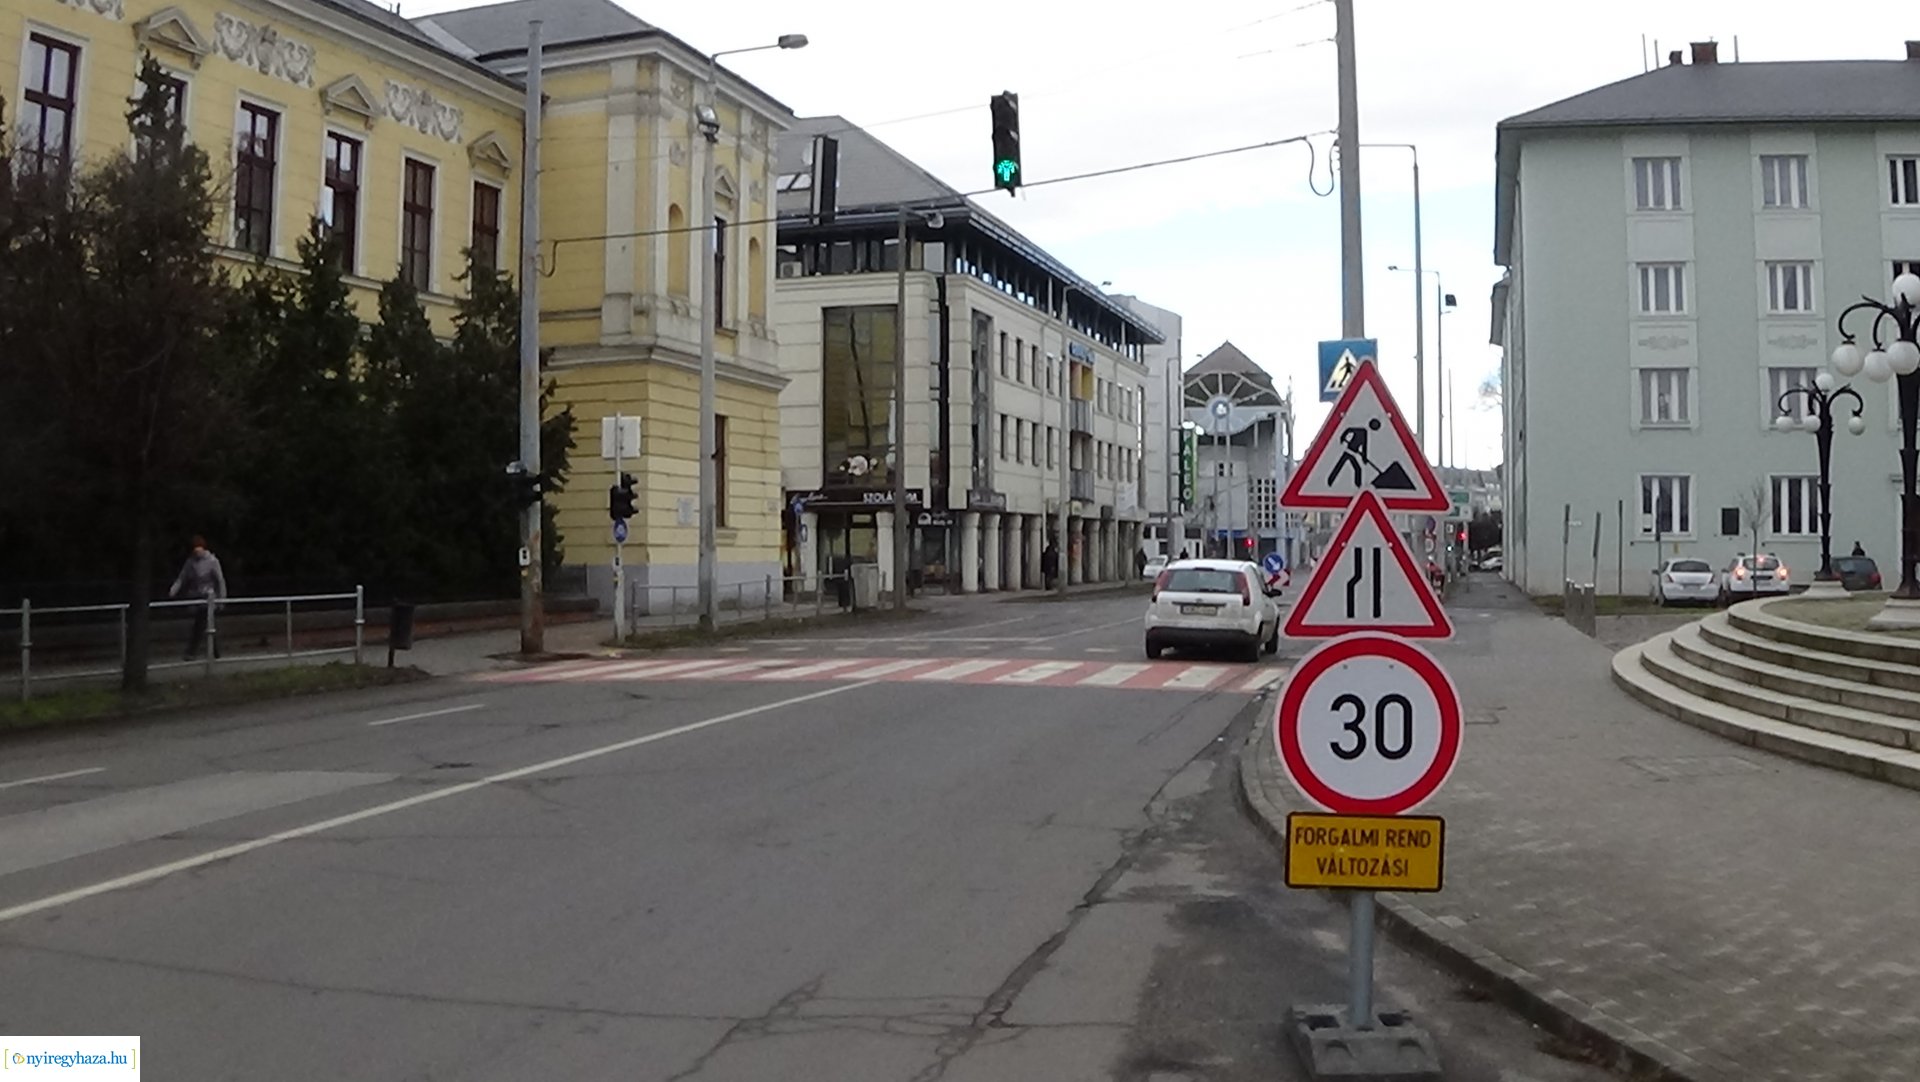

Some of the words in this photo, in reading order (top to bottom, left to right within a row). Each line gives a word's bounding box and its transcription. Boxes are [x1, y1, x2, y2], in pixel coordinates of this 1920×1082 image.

[1330, 693, 1413, 760] 30
[1295, 827, 1379, 847] FORGALMI
[1385, 829, 1432, 849] REND
[1316, 853, 1409, 877] VÁLTOZÁSI
